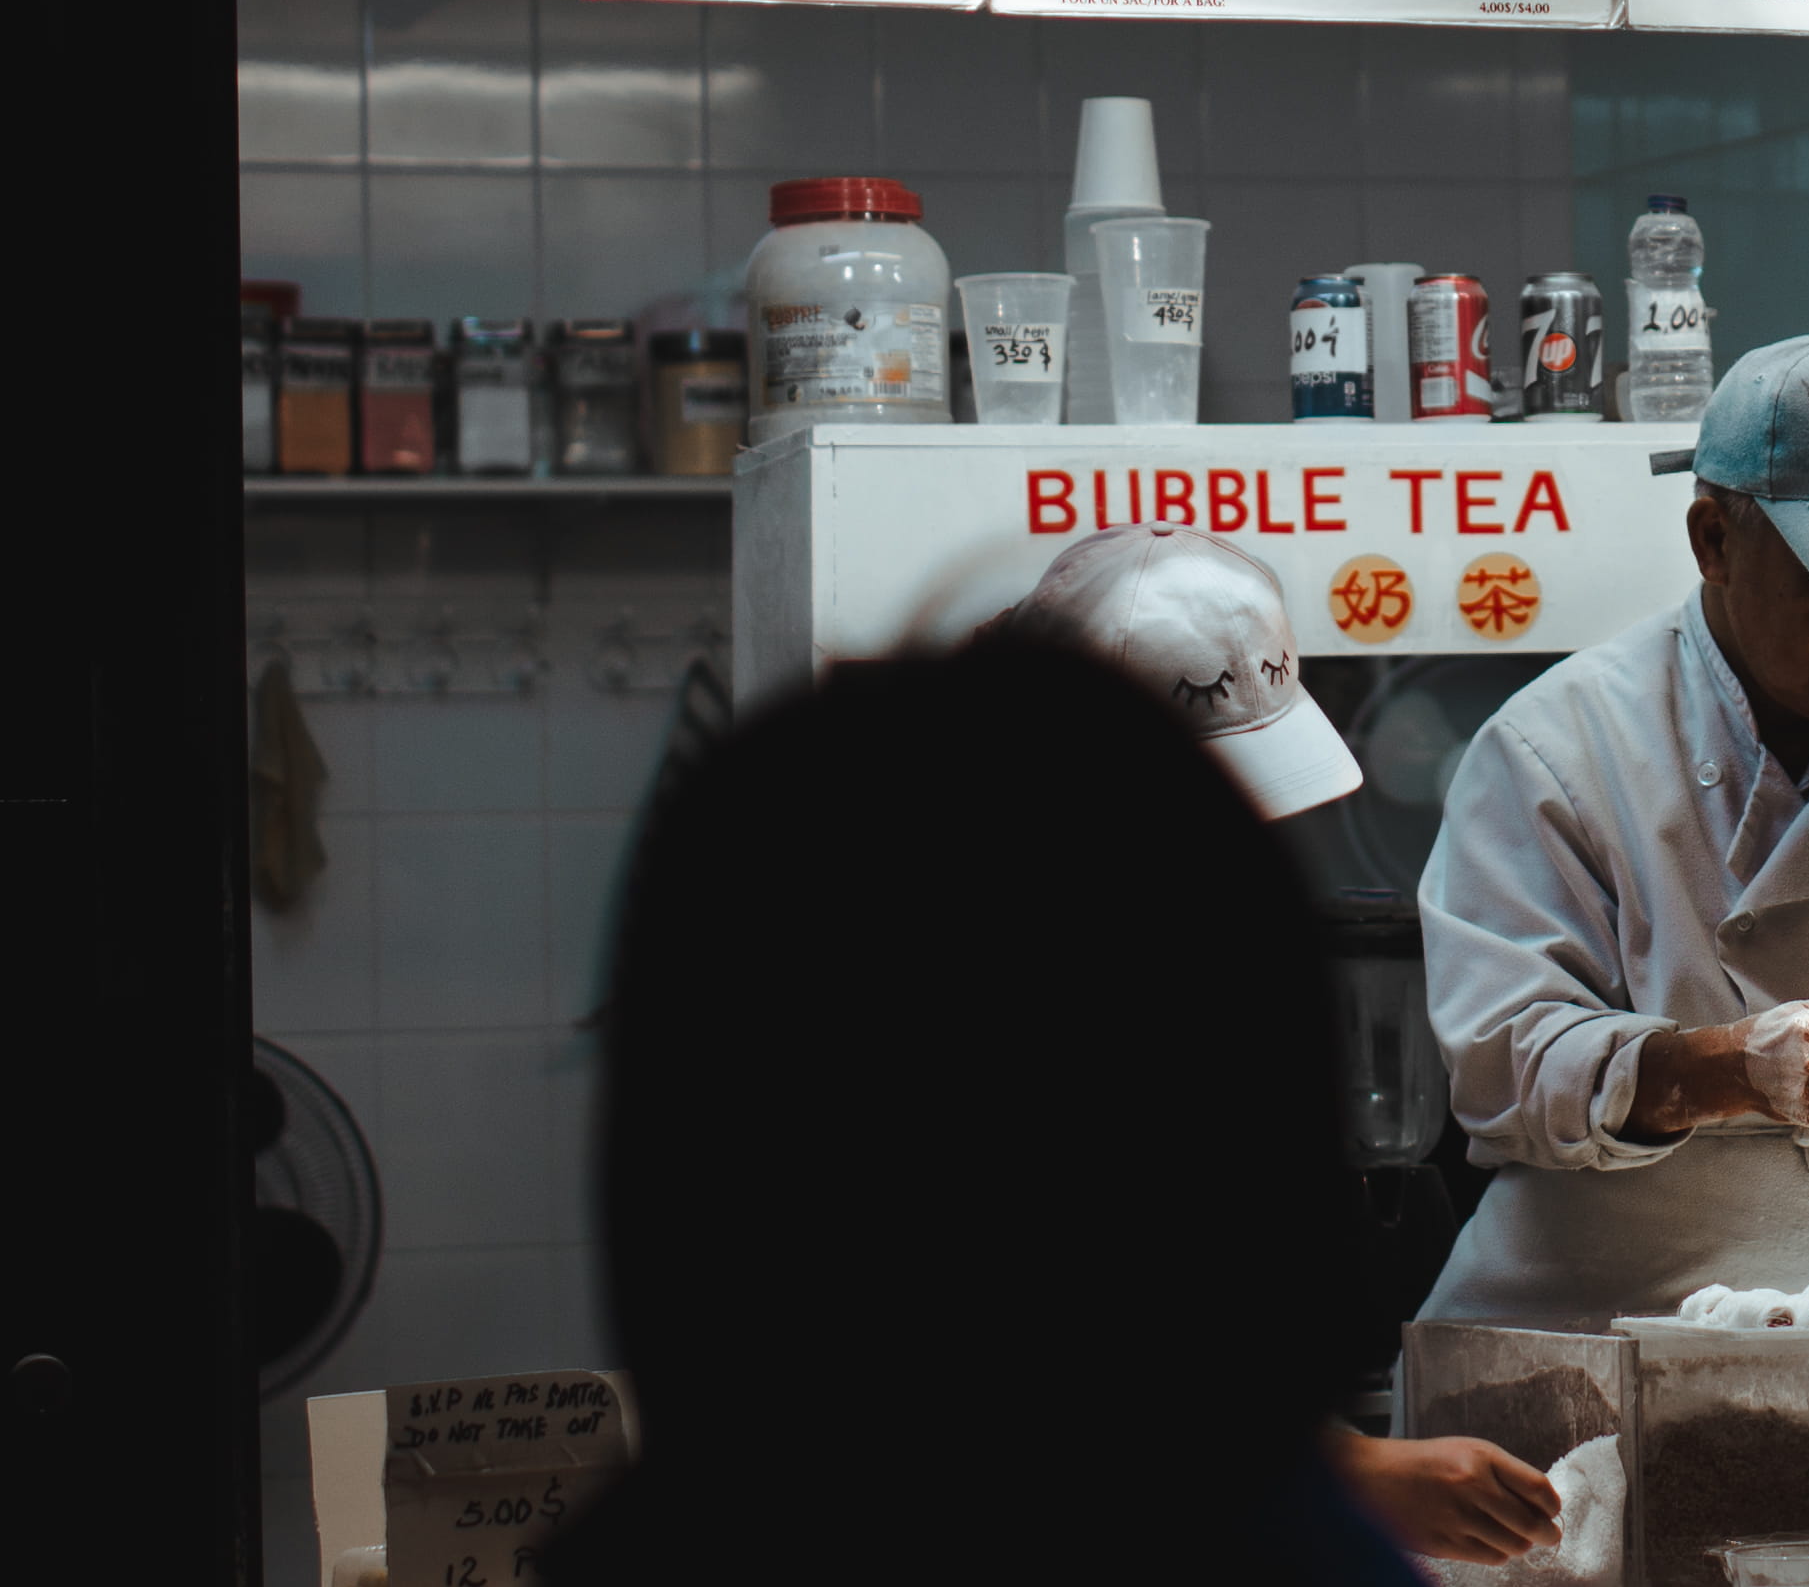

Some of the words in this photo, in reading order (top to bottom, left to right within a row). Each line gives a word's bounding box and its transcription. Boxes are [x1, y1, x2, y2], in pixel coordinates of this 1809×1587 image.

[1026, 466, 1349, 535] BUBBLE
[1389, 469, 1571, 535] TEA
[1330, 565, 1540, 636] 奶茶
[472, 1387, 496, 1411] NE
[503, 1381, 539, 1408] PAS
[545, 1379, 612, 1410] SORTIR
[394, 1423, 438, 1449] DO
[448, 1418, 486, 1444] NOT
[496, 1415, 548, 1440] TAKE
[566, 1410, 606, 1435] OUT
